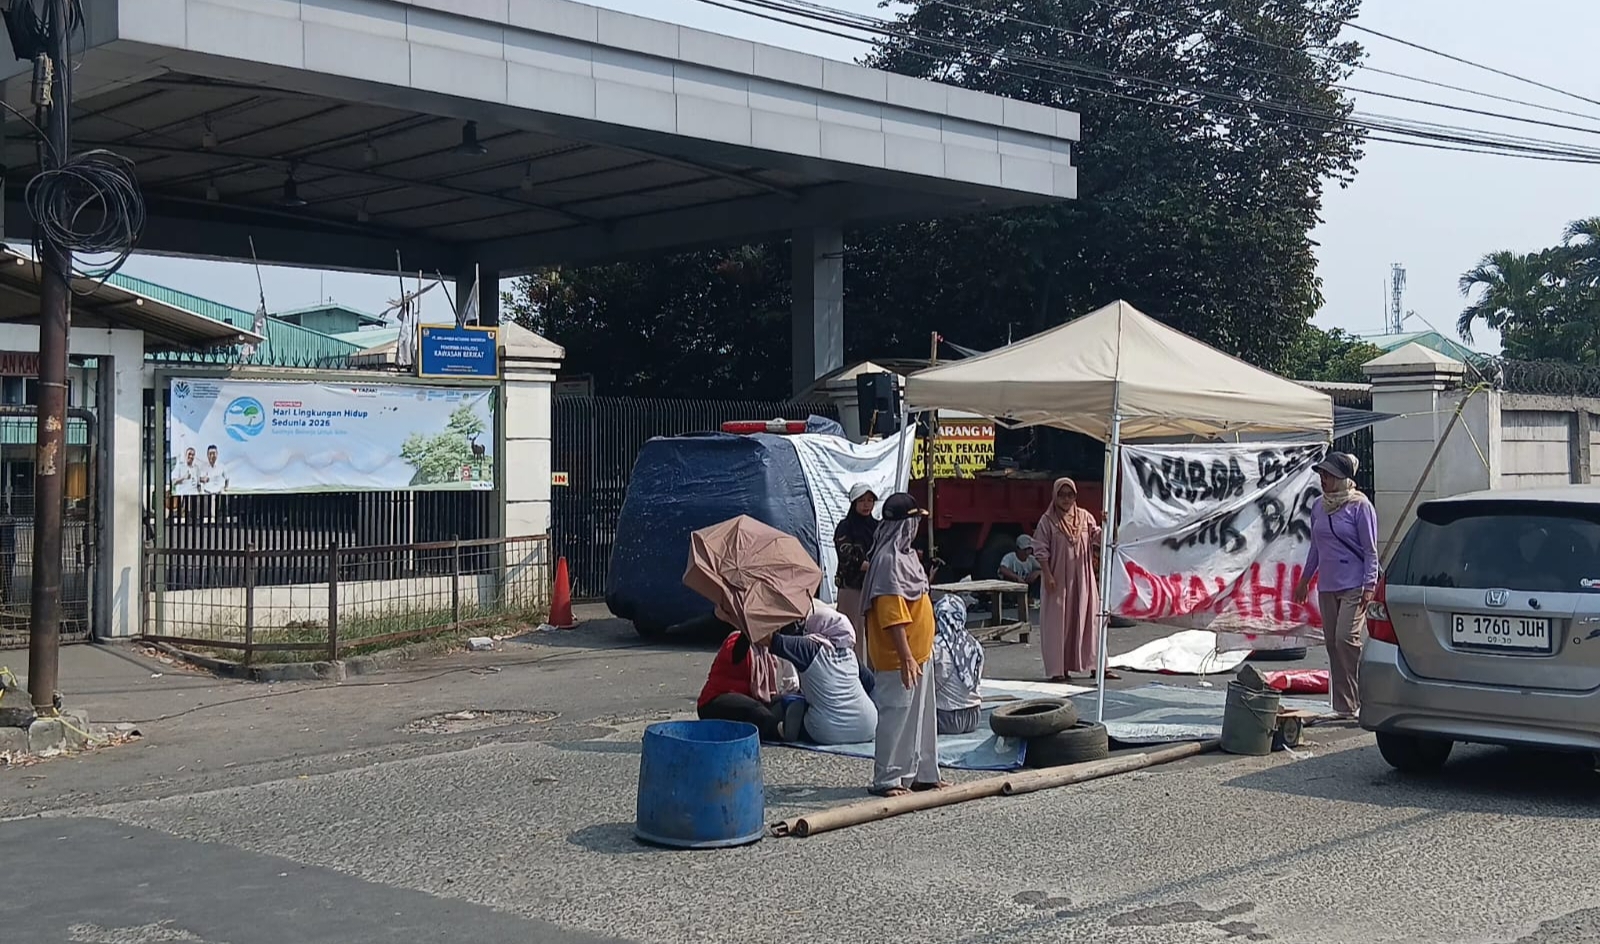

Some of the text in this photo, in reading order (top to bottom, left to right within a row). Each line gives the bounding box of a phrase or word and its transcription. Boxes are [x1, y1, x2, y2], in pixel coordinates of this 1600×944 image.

[0, 354, 16, 373] AN
[273, 408, 368, 419] Hari Lingkungan Hidup
[272, 419, 306, 427] Sedunia
[918, 443, 953, 453] MSUK
[950, 455, 971, 464] LAIN
[554, 475, 565, 483] IN
[1456, 617, 1545, 638] B 1760 JUH
